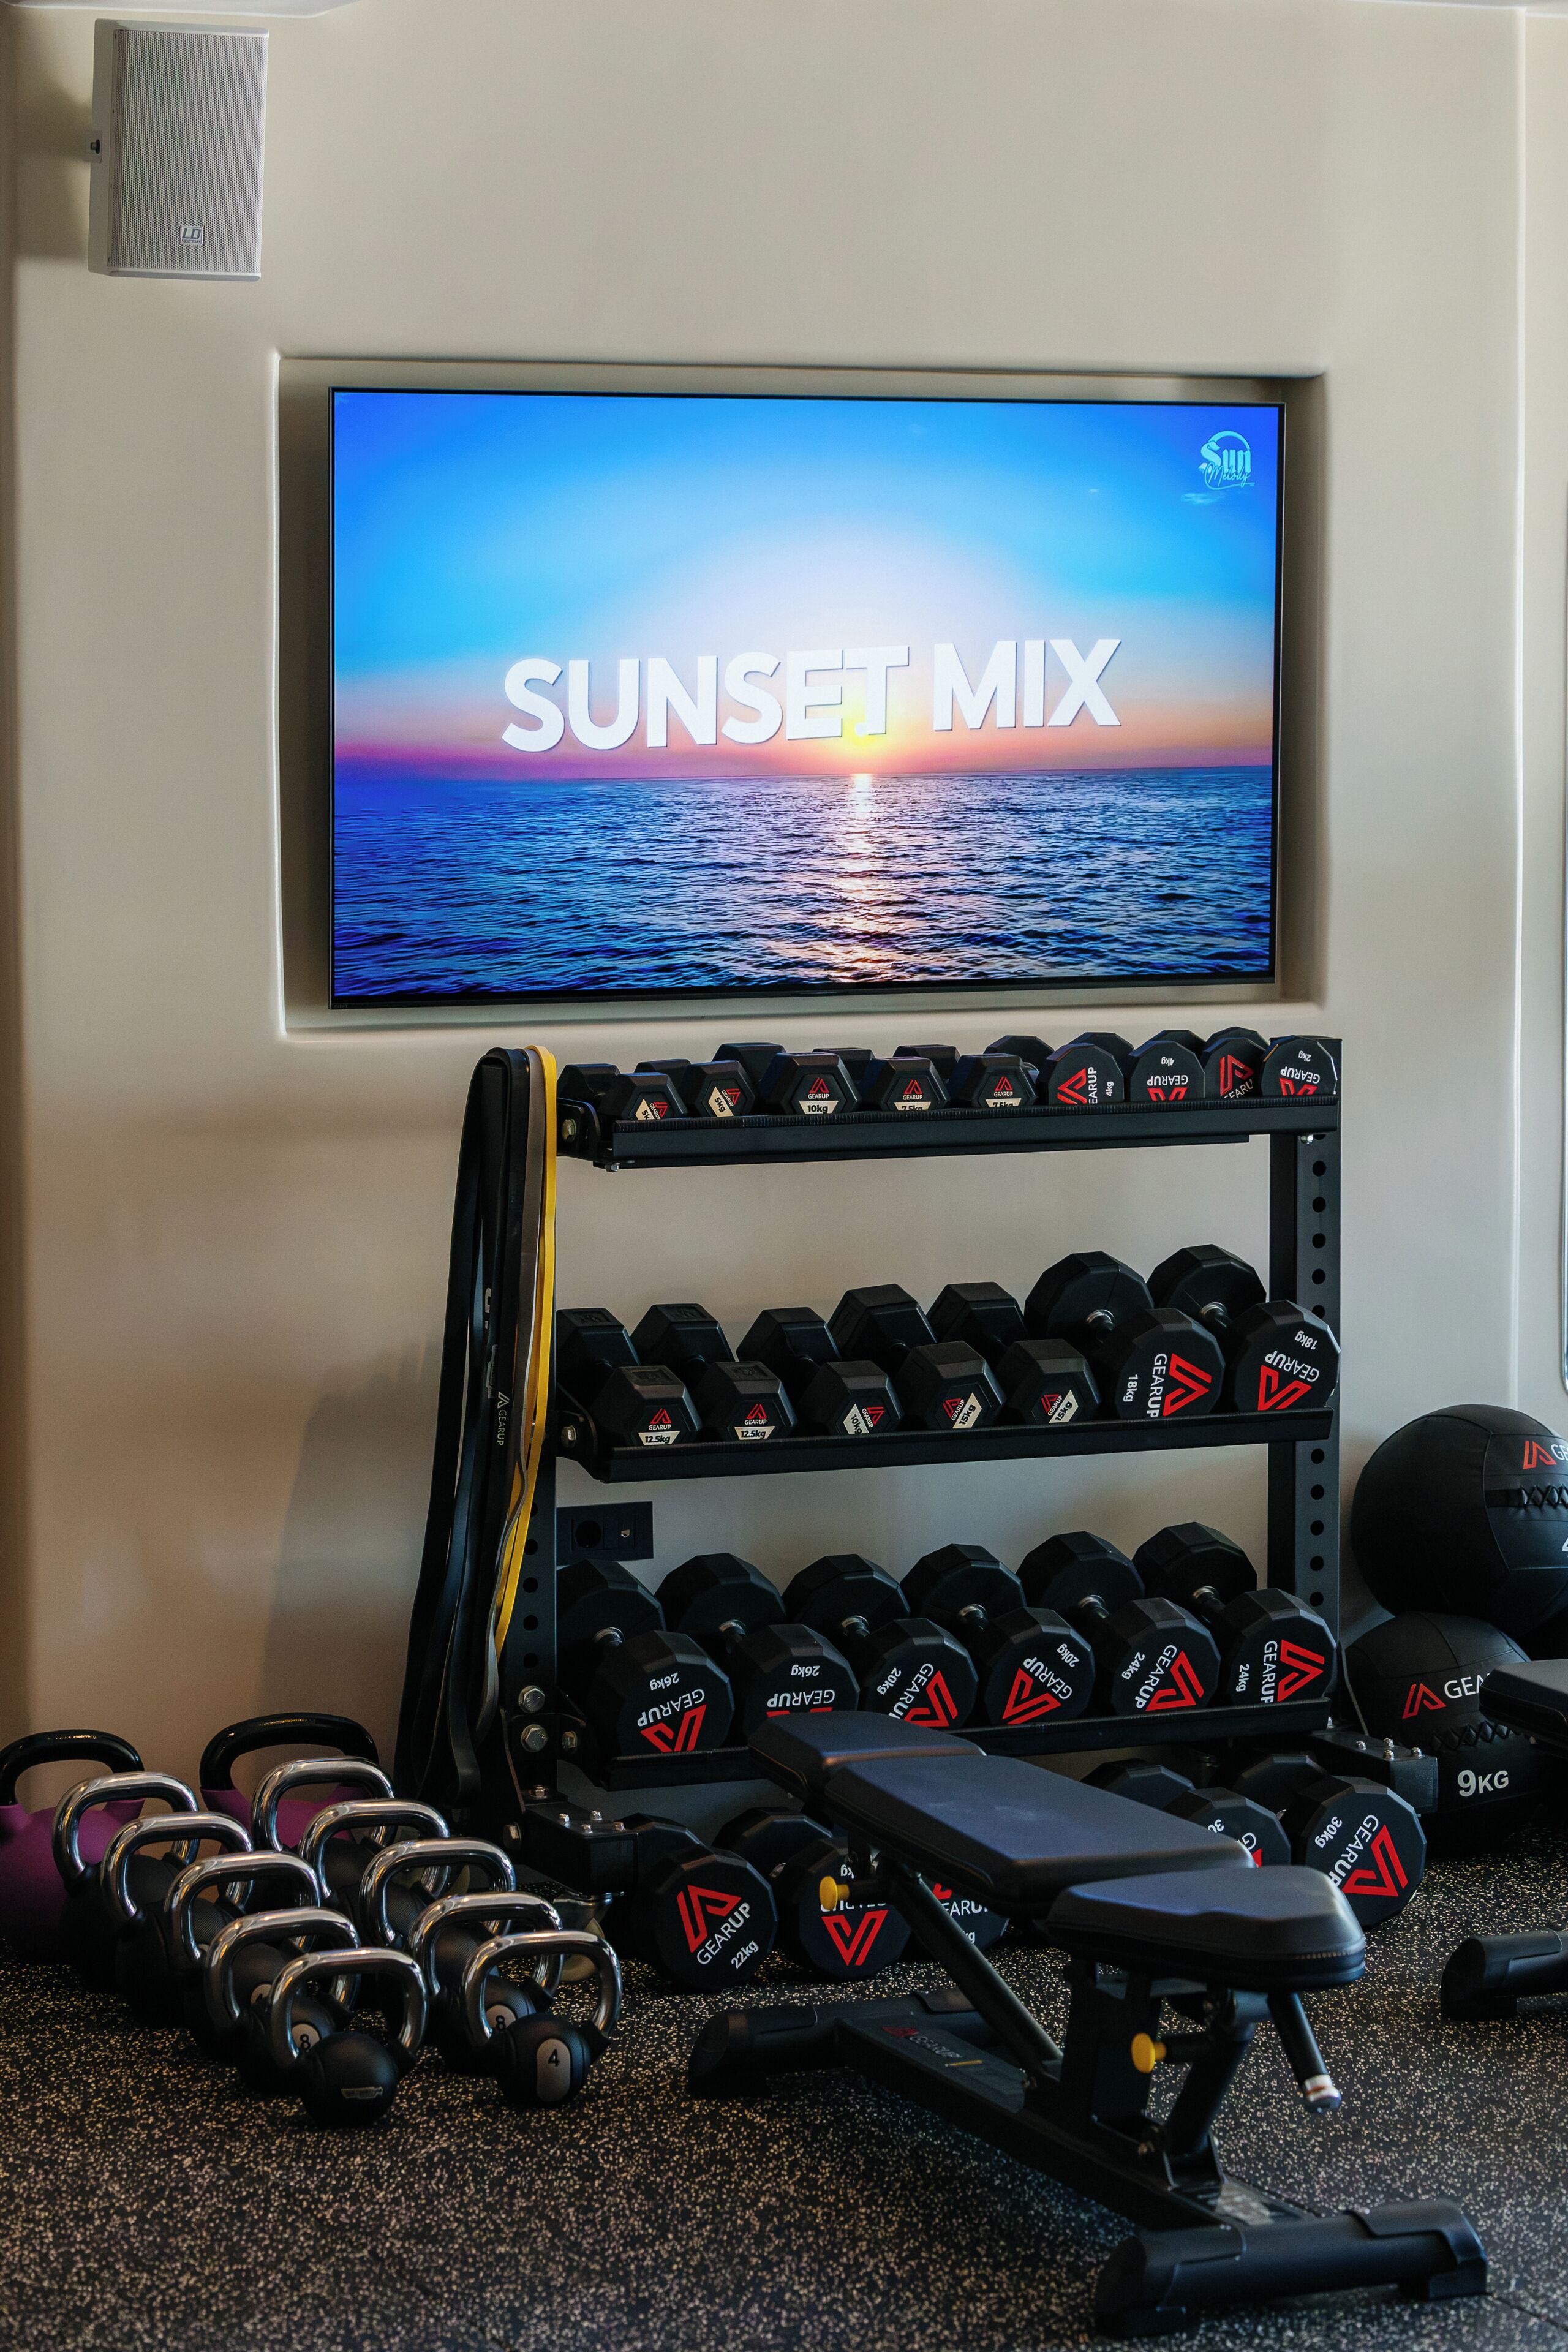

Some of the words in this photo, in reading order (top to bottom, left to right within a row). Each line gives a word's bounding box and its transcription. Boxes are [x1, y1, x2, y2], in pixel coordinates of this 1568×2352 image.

[182, 228, 201, 239] LD
[1198, 440, 1251, 474] Sun
[501, 646, 910, 753] SUNSET
[933, 639, 1122, 731] MIX
[1161, 1057, 1175, 1066] 4kg
[1298, 1050, 1313, 1062] 2kg
[1088, 1066, 1098, 1104] EARUP
[1147, 1075, 1188, 1087] GEARUP
[1280, 1066, 1321, 1084] GEARUP
[722, 1090, 734, 1107] GEARUP
[1106, 1081, 1114, 1097] 4kg
[1224, 1079, 1253, 1099] EARU
[714, 1097, 726, 1113] 5kg
[807, 1104, 829, 1114] 10kg
[1294, 1330, 1318, 1350] 18kg
[1265, 1350, 1320, 1383] GEARUP
[1123, 1374, 1139, 1403] 18kg
[1147, 1353, 1167, 1418] GEARUP
[951, 1399, 965, 1421] GEARUP
[959, 1404, 976, 1425] 15kg
[1047, 1395, 1063, 1416] GEARUP
[1055, 1401, 1073, 1422] 15kg
[497, 1409, 507, 1446] GEARUP
[850, 1414, 863, 1434] 10kg
[861, 1408, 873, 1428] GEARUP
[645, 1435, 671, 1444] 12.5kg
[741, 1430, 766, 1439] 12.5kg
[1057, 1643, 1080, 1668] 20kg
[1121, 1651, 1146, 1681] 24kg
[649, 1672, 680, 1691] 26kg
[791, 1664, 821, 1678] 26kg
[877, 1667, 902, 1695] 20kg
[1023, 1656, 1073, 1700] GEARUP
[1135, 1644, 1178, 1709] GEARUP
[1235, 1663, 1251, 1692] 24kg
[1260, 1640, 1278, 1703] GEARUP
[767, 1689, 836, 1708] GEARUP
[888, 1663, 935, 1719] GEARU
[637, 1688, 706, 1727] GEARUP
[1457, 1770, 1510, 1797] 9KG
[1314, 1816, 1343, 1849] 30kg
[1329, 1814, 1379, 1888] GEARUP
[696, 1902, 751, 1965] GEARUP
[731, 1940, 760, 1969] 22kg
[496, 2015, 506, 2030] 8
[300, 2034, 311, 2049] 8
[548, 2049, 560, 2067] 4
